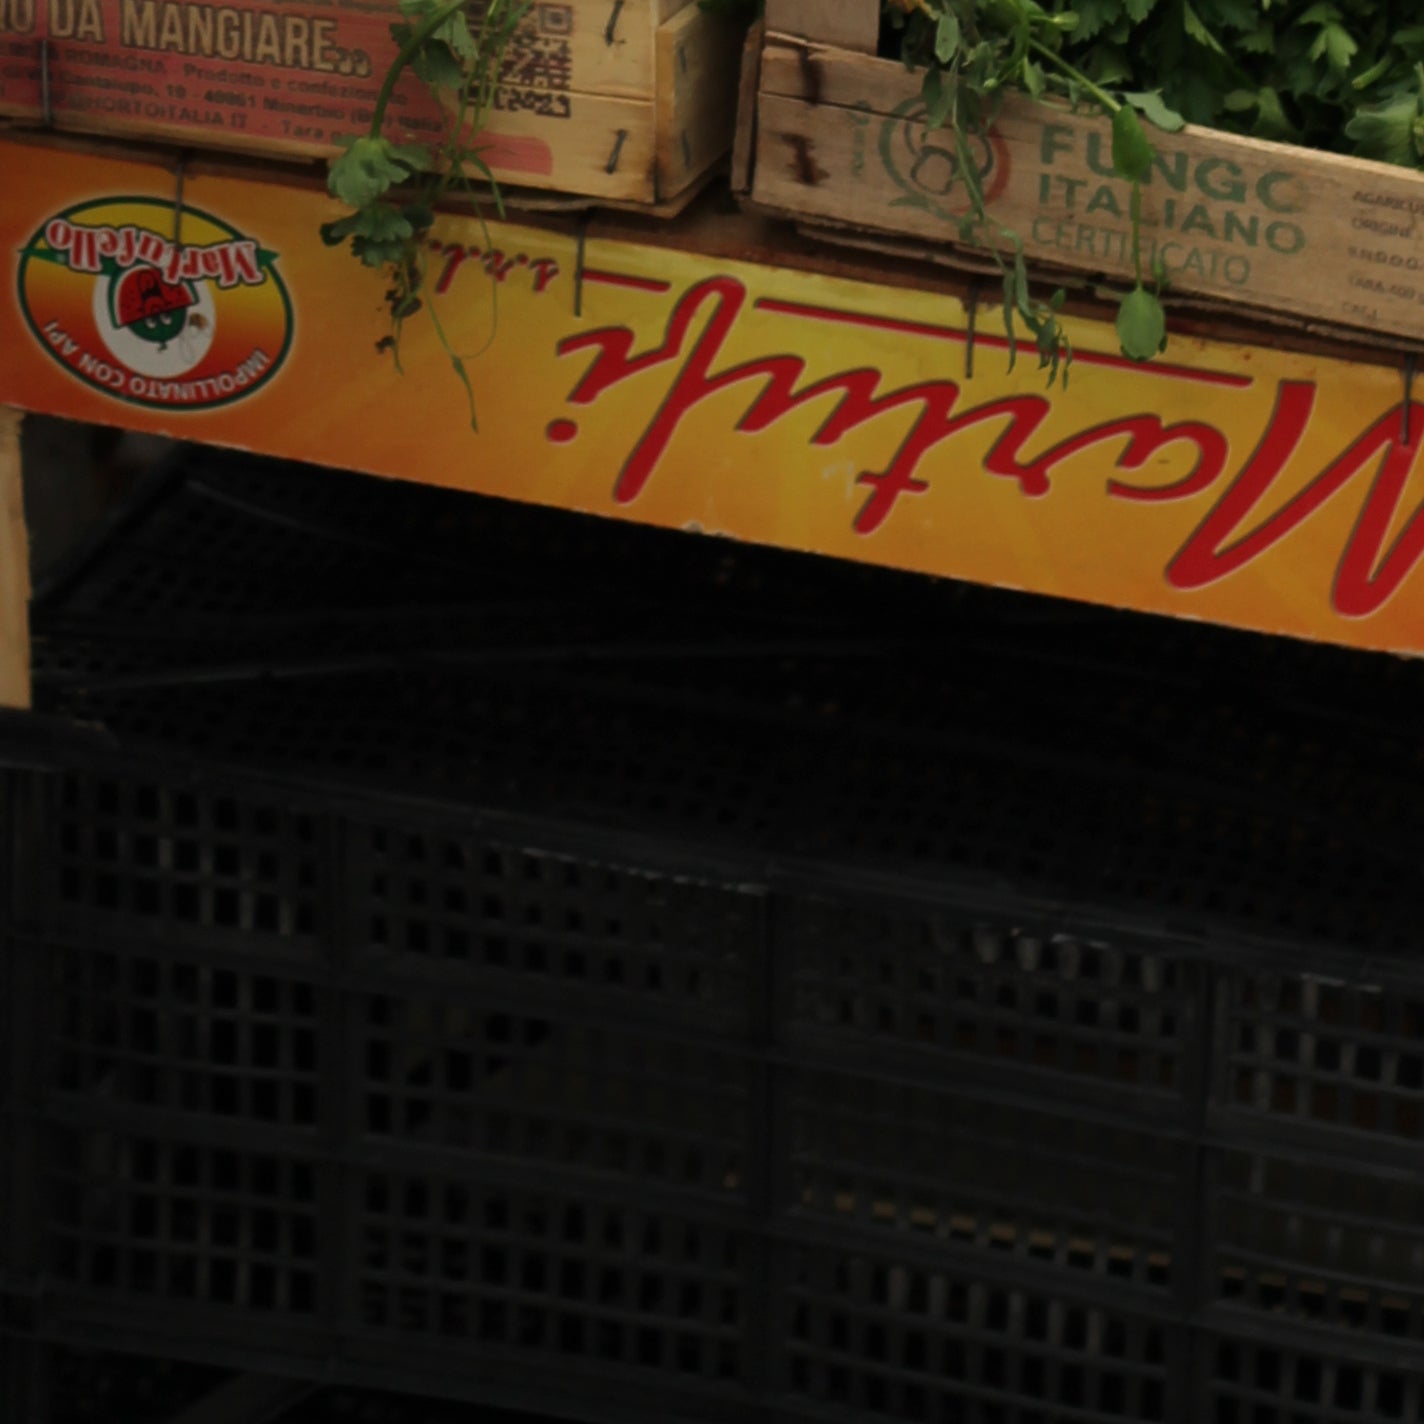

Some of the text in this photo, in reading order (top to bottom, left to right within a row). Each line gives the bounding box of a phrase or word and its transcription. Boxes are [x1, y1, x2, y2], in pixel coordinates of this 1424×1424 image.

[45, 218, 266, 289] Martufello
[1038, 173, 1307, 255] ITALIANO
[42, 319, 271, 401] IMPOLLINATO CON API
